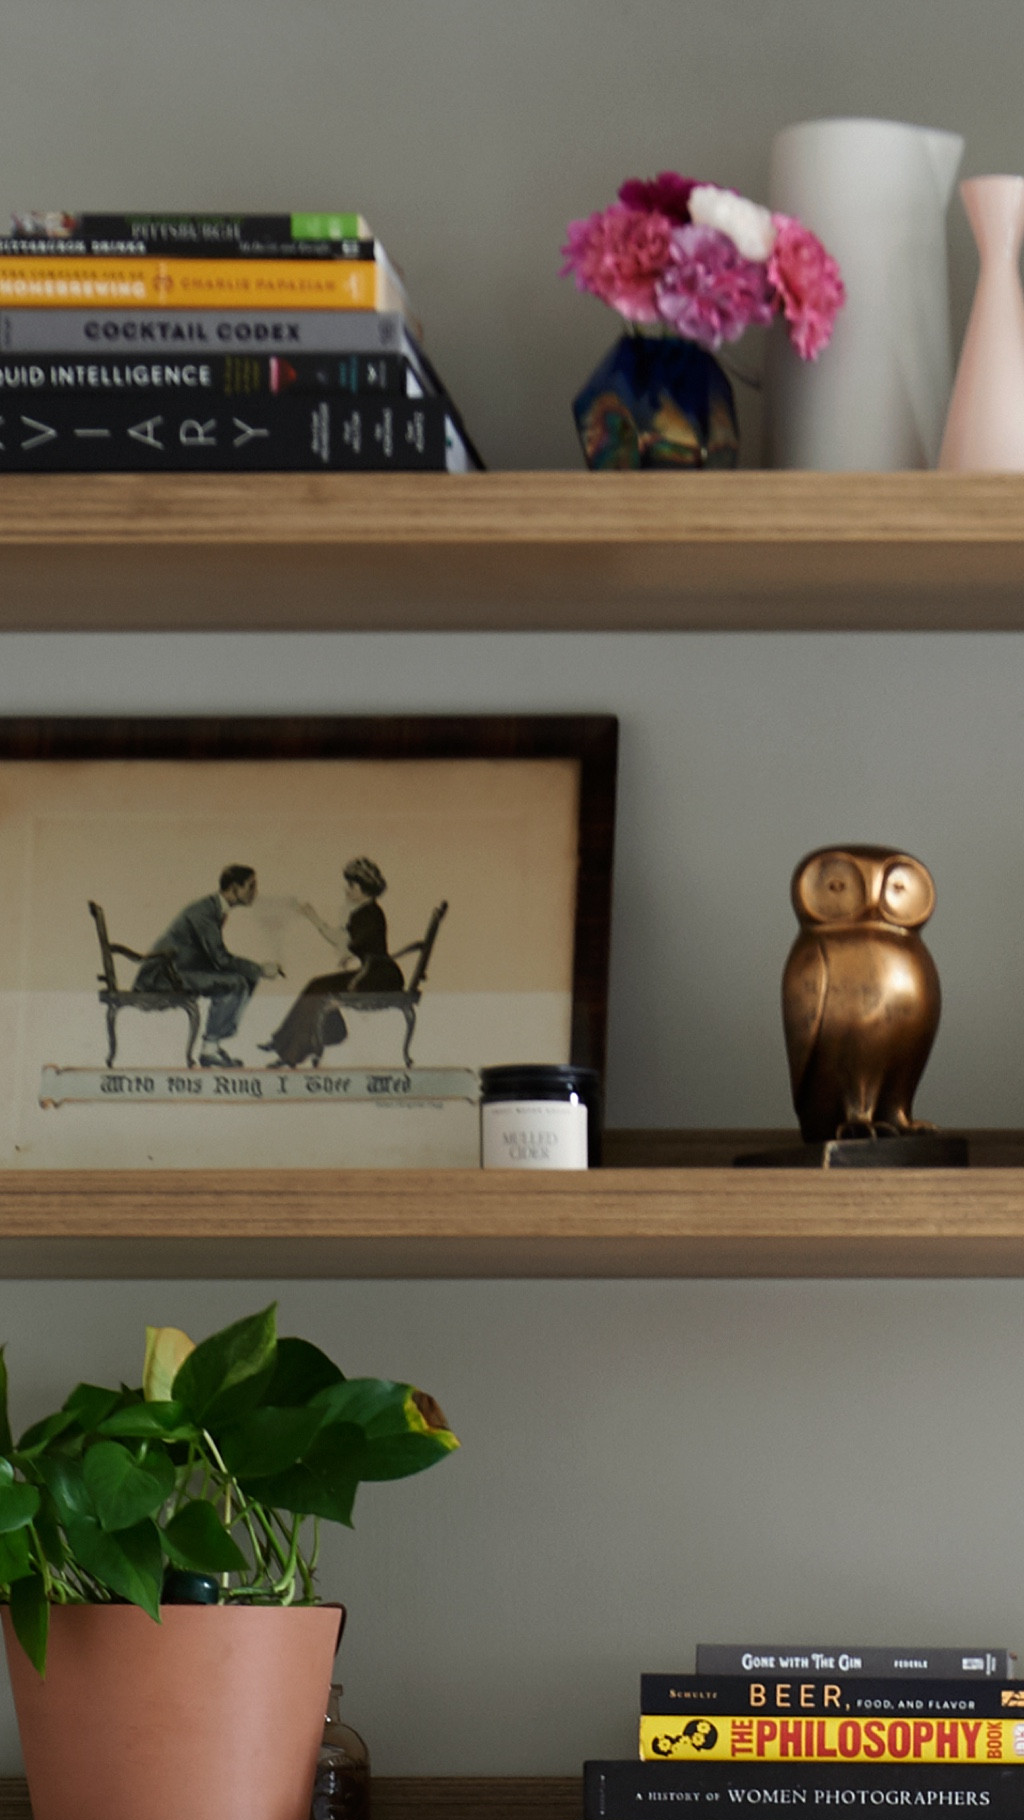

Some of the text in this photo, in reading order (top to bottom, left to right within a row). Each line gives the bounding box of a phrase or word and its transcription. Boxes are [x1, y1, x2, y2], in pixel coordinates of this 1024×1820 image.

[83, 320, 300, 343] COCKTAIL CODEX
[0, 365, 45, 388] UID
[51, 364, 212, 388] INTELLIGENCE
[213, 1075, 263, 1097] Ring
[277, 1076, 288, 1094] I
[741, 1653, 775, 1671] GONE
[838, 1654, 862, 1672] GIN
[894, 1659, 928, 1669] FEDERLE
[750, 1683, 976, 1711] BEER, FOOD, AND FLAVOR
[731, 1719, 754, 1758] THE
[756, 1719, 983, 1760] PHILOSOPHY
[986, 1720, 1003, 1760] BOOK
[635, 1789, 991, 1806] A HISTORY OF WOMEN PHOTOGRAPHERS
